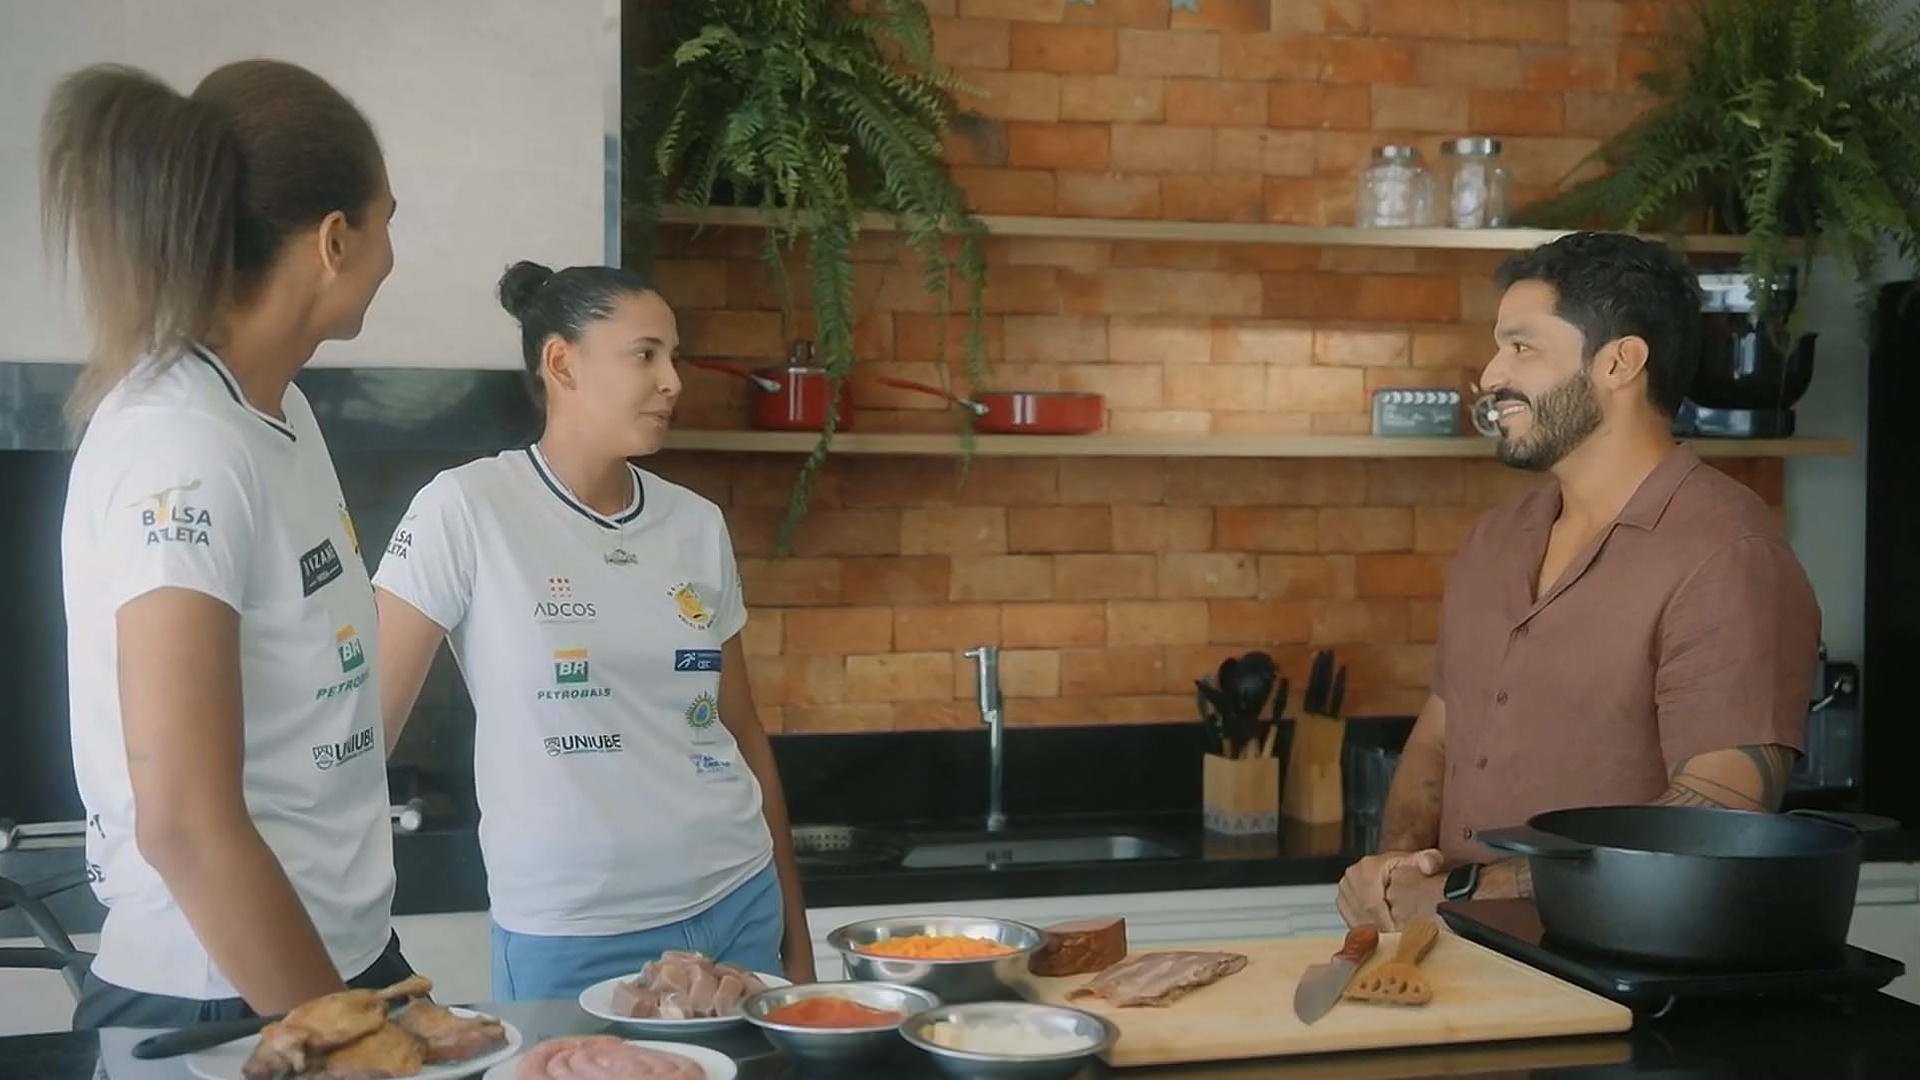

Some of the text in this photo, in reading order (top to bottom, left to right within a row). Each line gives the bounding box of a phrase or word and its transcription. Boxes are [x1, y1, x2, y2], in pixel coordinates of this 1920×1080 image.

[147, 526, 210, 546] ATLETA
[534, 602, 597, 617] ADCOS
[558, 662, 586, 676] BR
[316, 668, 370, 700] PETRO
[562, 734, 622, 750] UNIUBE
